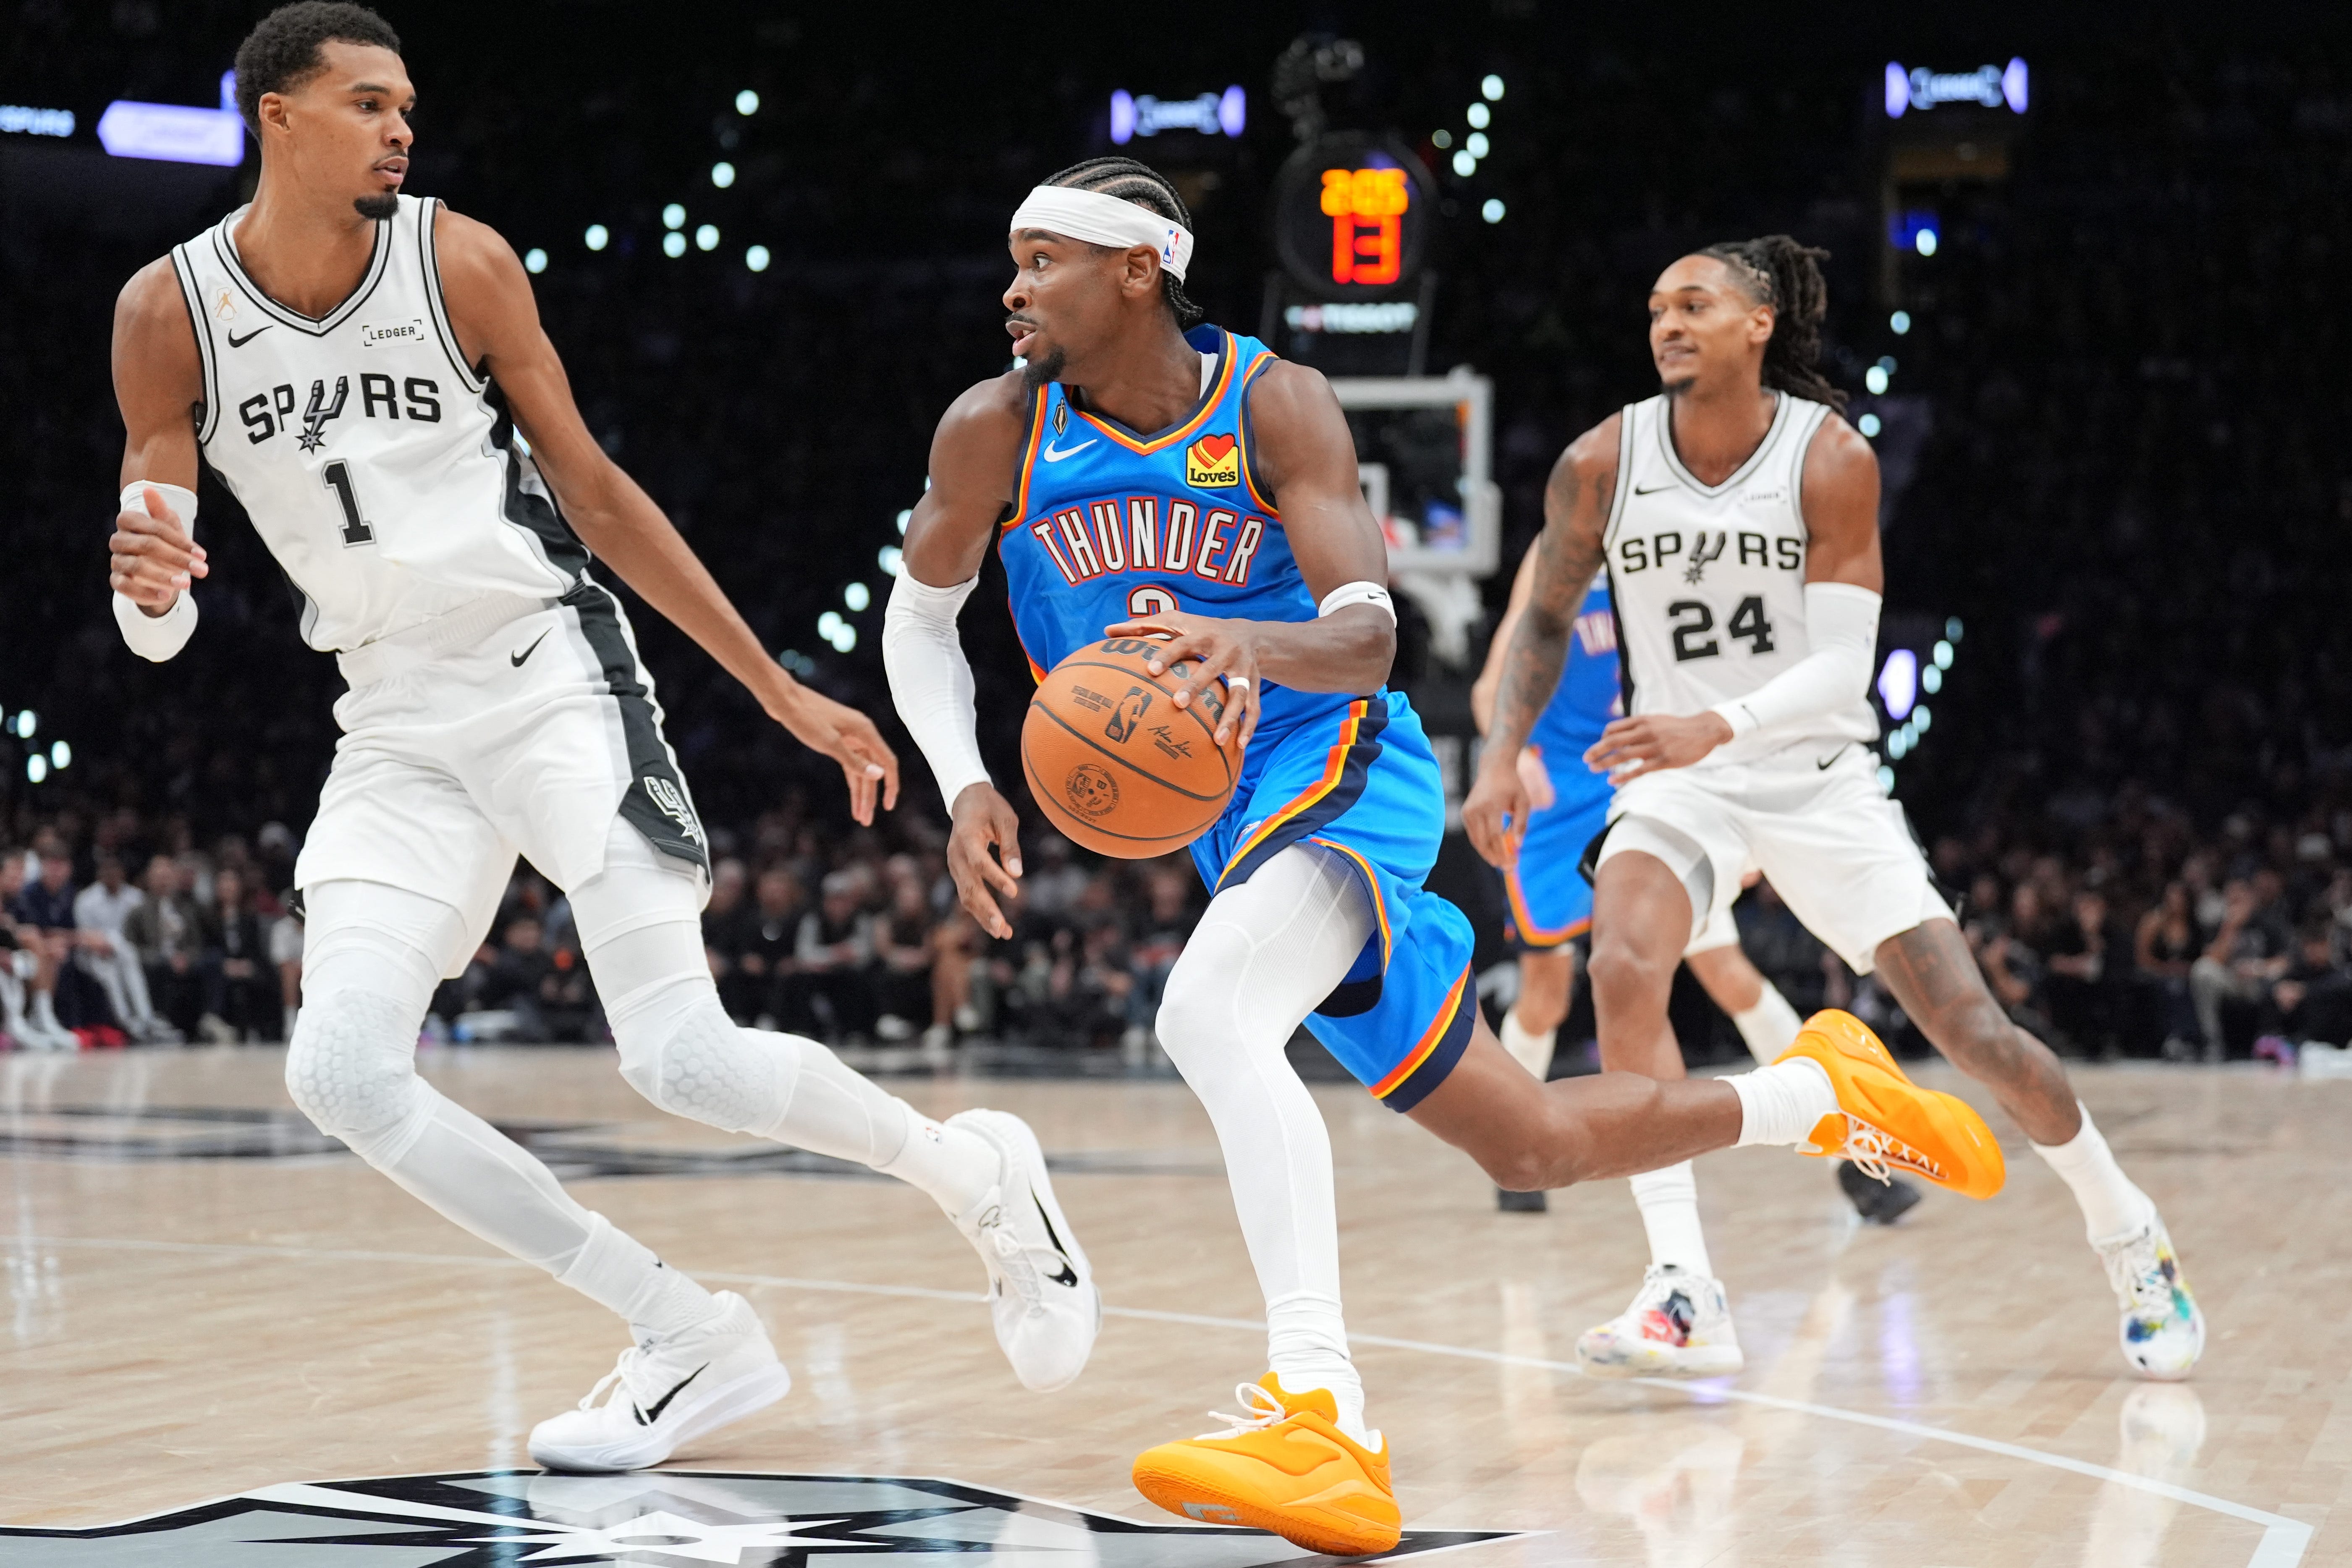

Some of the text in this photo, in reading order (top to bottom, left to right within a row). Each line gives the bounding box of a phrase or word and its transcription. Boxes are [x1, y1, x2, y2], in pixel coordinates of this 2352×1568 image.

[1333, 212, 1401, 285] 13
[370, 326, 415, 340] LEDGER
[239, 373, 441, 455] SPURS
[321, 458, 377, 548] 1
[1029, 496, 1264, 587] THUNDER
[1621, 531, 1802, 584] SPURS
[1666, 594, 1776, 663] 24
